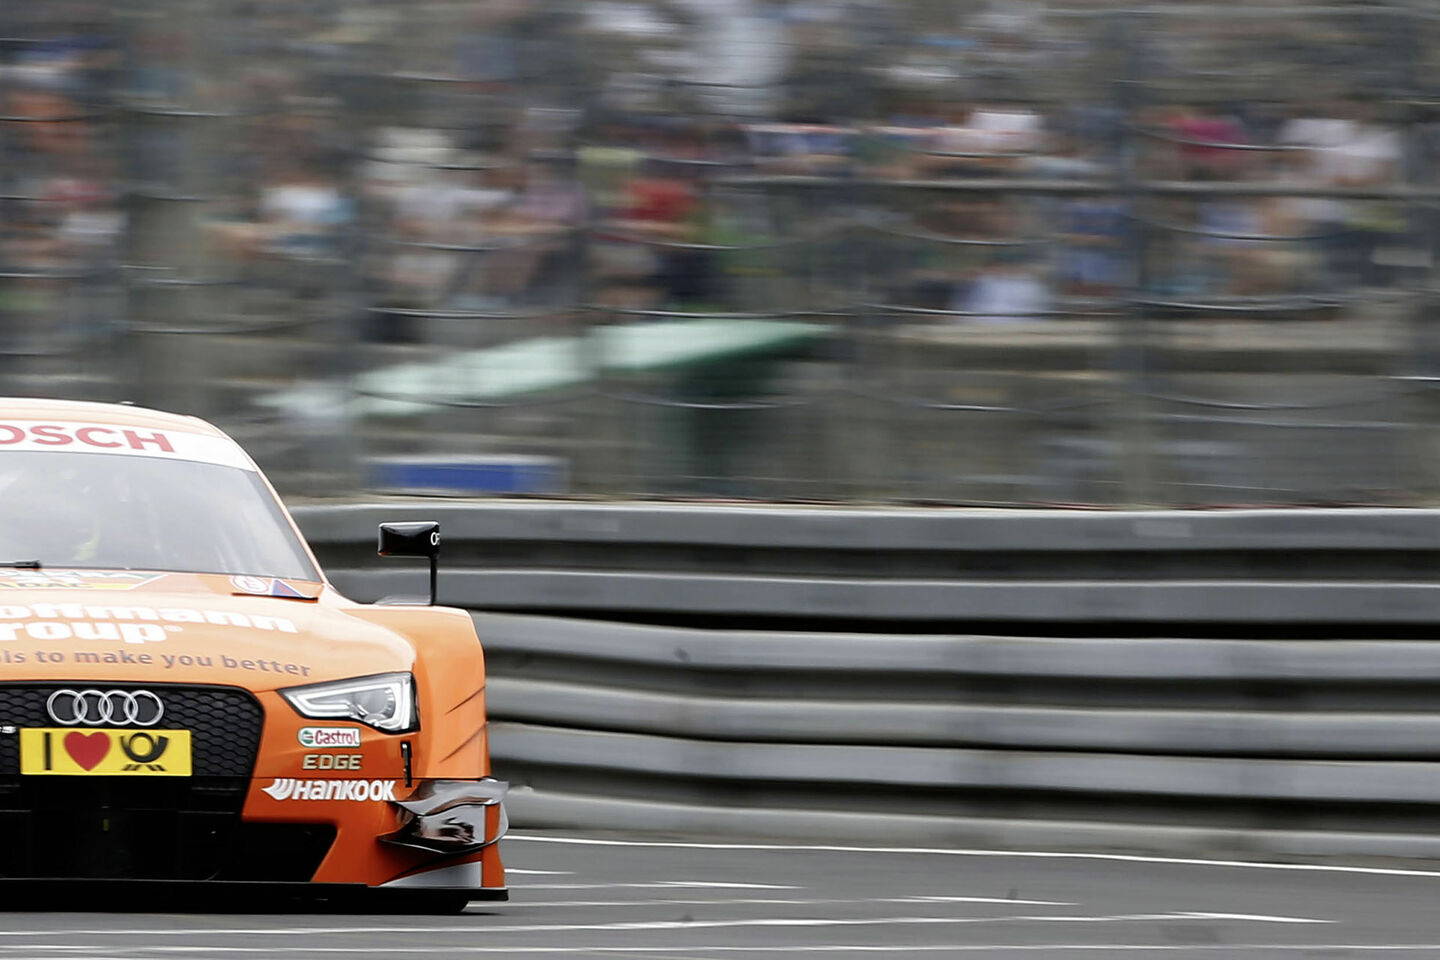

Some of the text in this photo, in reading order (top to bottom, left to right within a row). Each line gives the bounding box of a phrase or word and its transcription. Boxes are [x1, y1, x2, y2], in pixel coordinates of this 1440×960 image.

[37, 651, 65, 664] to
[74, 649, 154, 665] make
[156, 653, 213, 670] you
[221, 654, 312, 678] better
[315, 729, 360, 745] Castrol
[302, 754, 364, 771] EDGE
